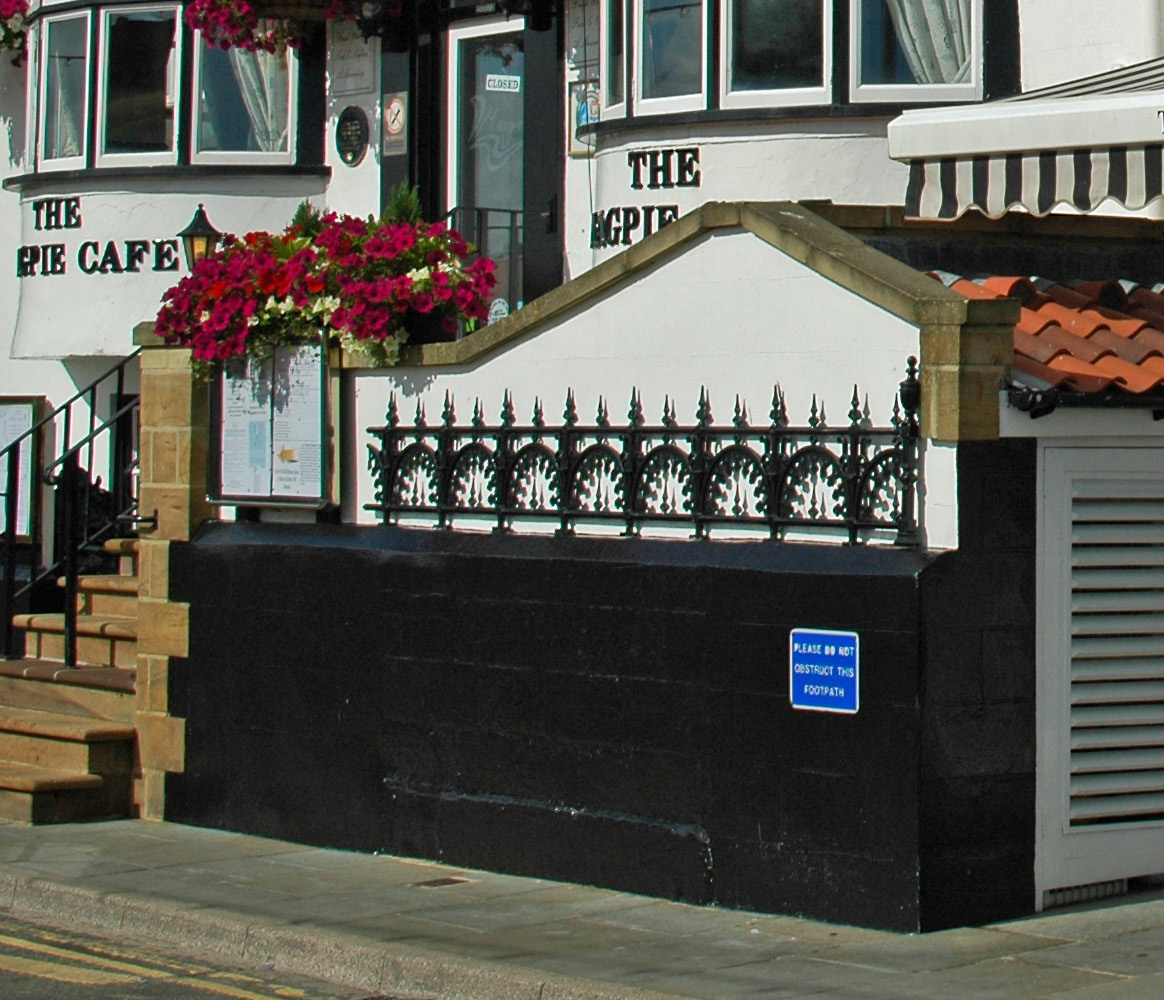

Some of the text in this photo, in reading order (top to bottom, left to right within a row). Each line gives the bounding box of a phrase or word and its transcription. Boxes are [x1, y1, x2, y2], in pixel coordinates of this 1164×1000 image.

[488, 79, 518, 89] CLOSED
[628, 148, 701, 189] THE
[33, 197, 82, 230] THE
[78, 240, 180, 274] CAFE
[793, 643, 854, 657] PLEASE DO NOT
[794, 664, 854, 678] OBSTRUCT THIS
[804, 684, 845, 697] FOOTPATH
